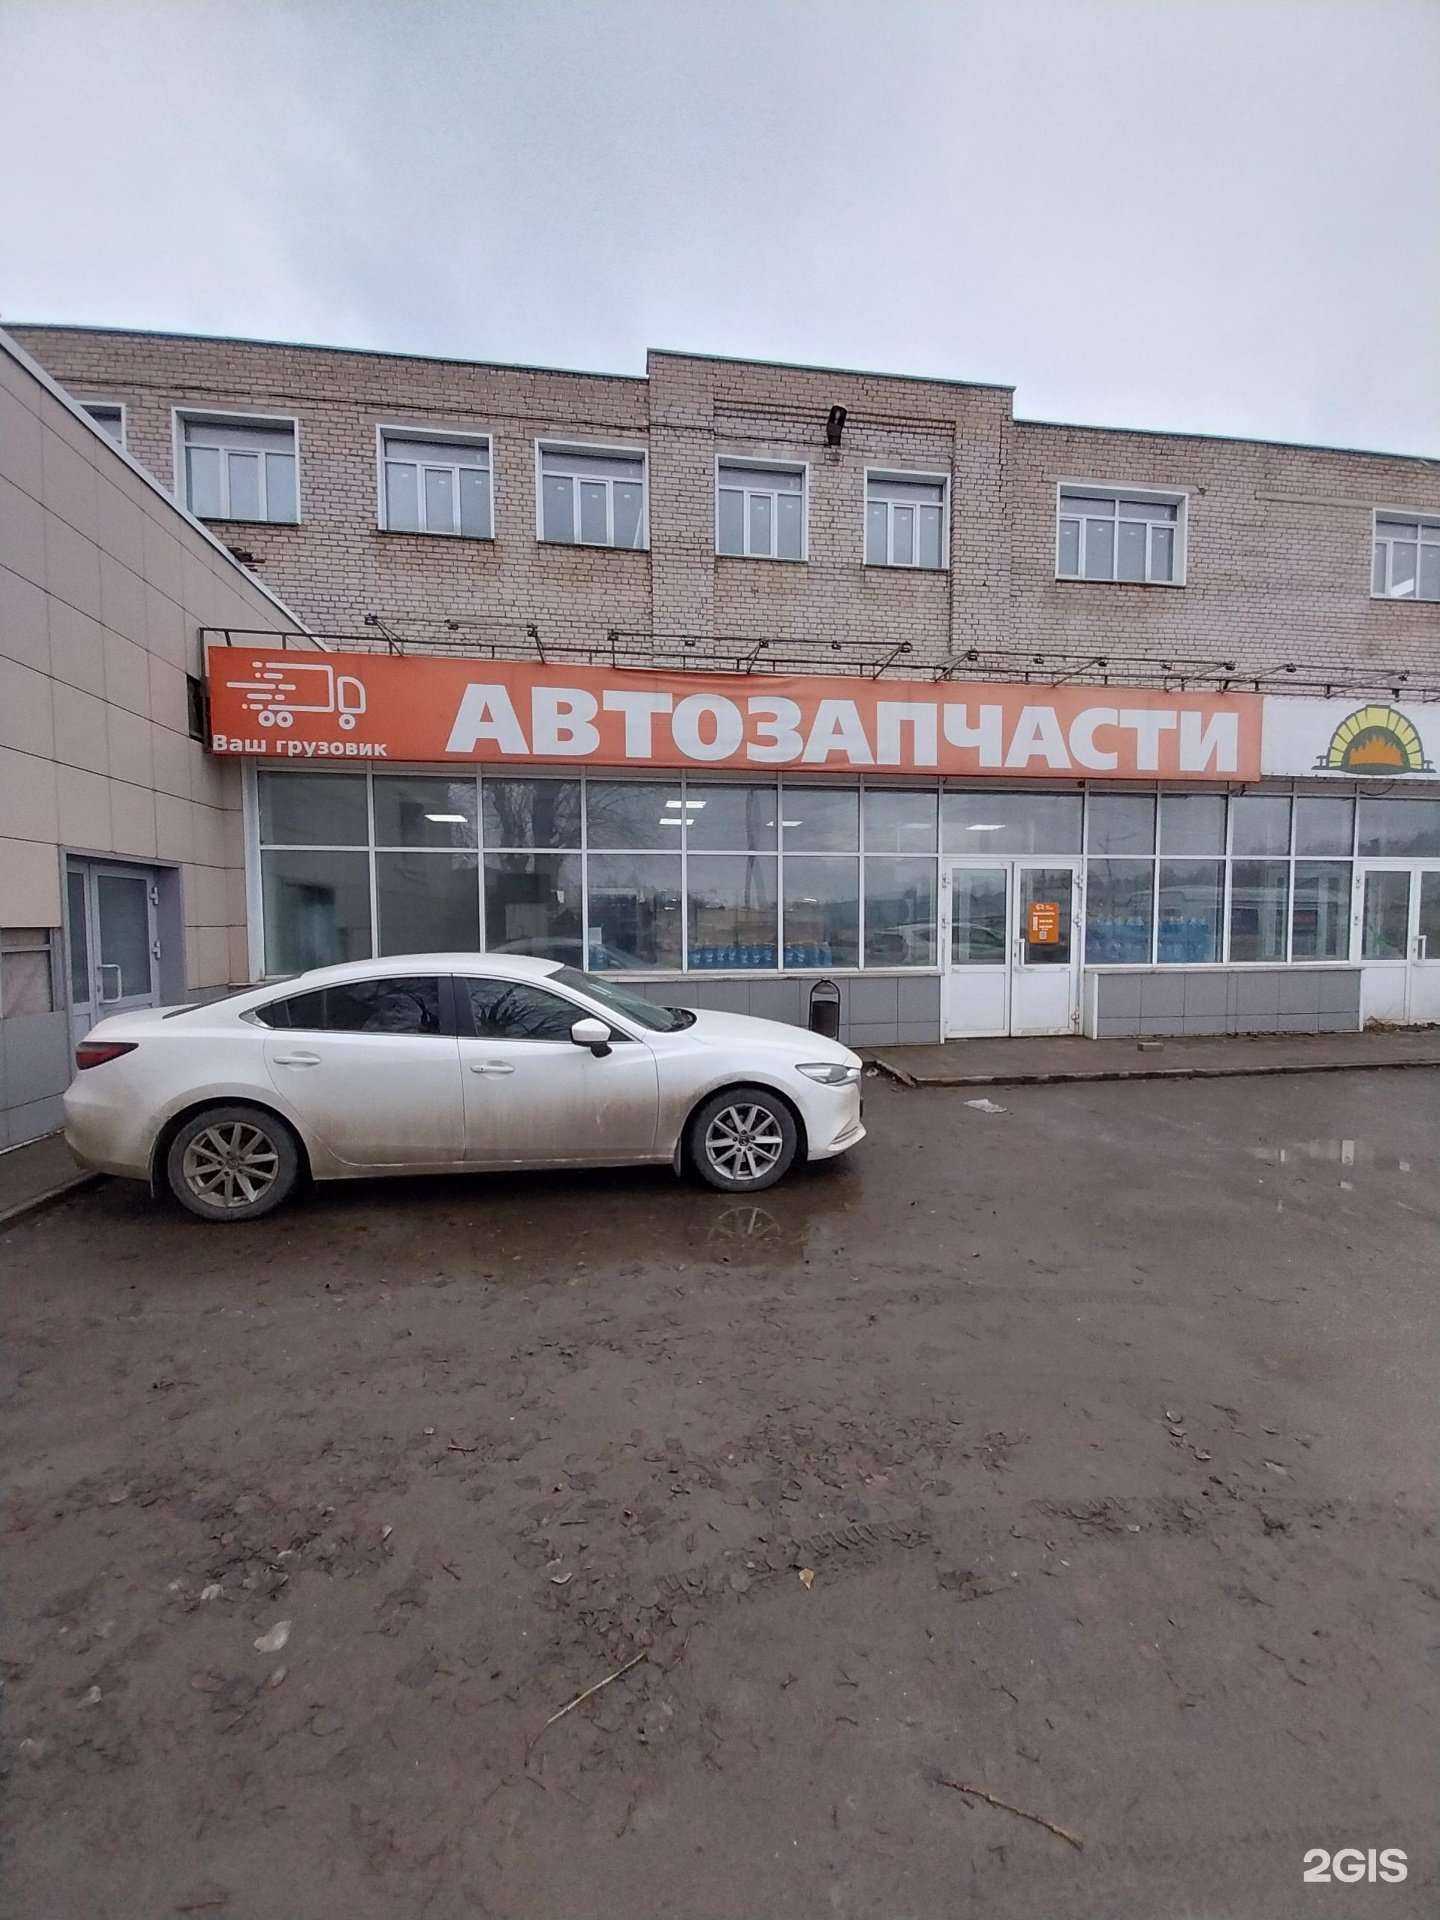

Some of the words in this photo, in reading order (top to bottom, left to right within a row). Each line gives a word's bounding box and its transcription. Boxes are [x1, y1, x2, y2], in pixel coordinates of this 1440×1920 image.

[212, 734, 267, 753] Ваш
[276, 738, 388, 757] грузовик
[445, 683, 1240, 773] АВТОЗАПЧАСТИ
